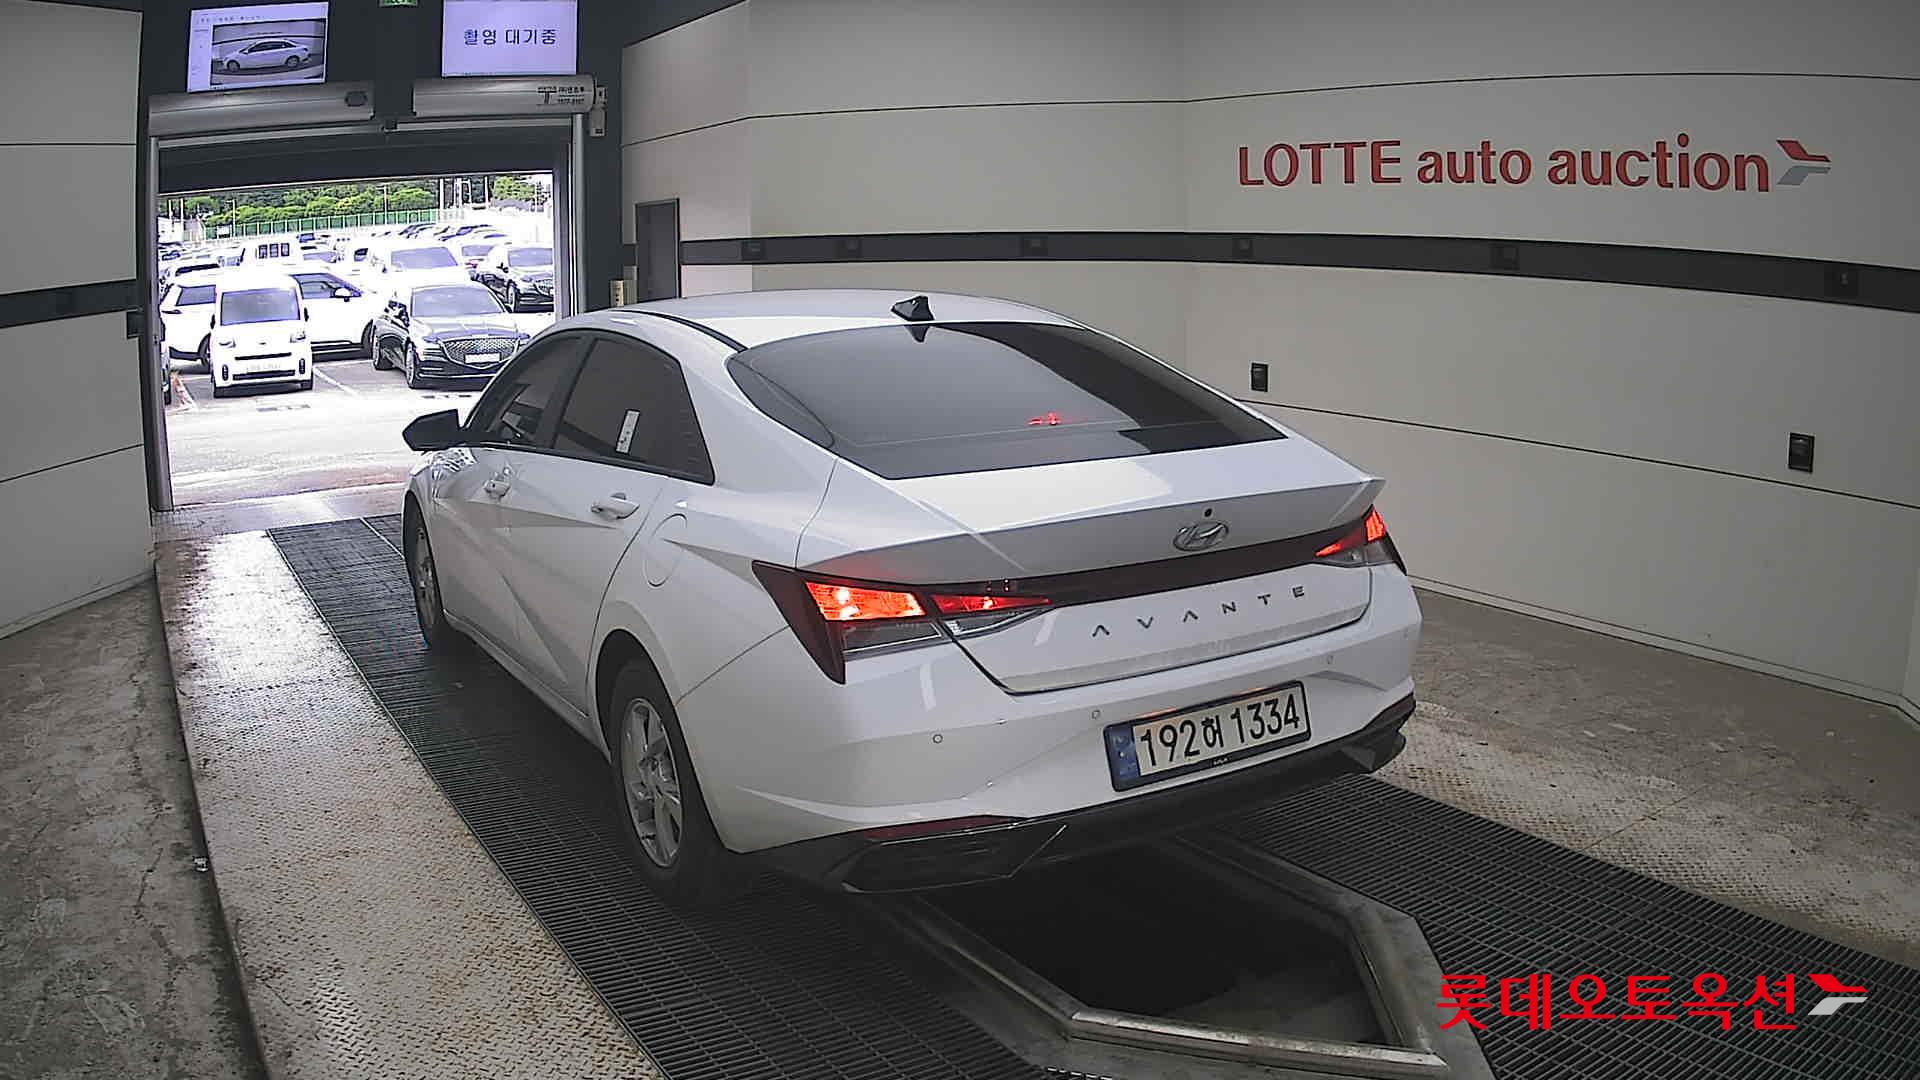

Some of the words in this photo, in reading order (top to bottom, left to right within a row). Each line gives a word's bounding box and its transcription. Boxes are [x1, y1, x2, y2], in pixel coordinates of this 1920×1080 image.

[463, 29, 497, 46] 촬영
[504, 29, 557, 46] 대기중
[1239, 140, 1402, 188] LOTTE
[1417, 140, 1533, 186] auto
[1547, 133, 1770, 193] auction
[1091, 585, 1305, 638] AVANTE
